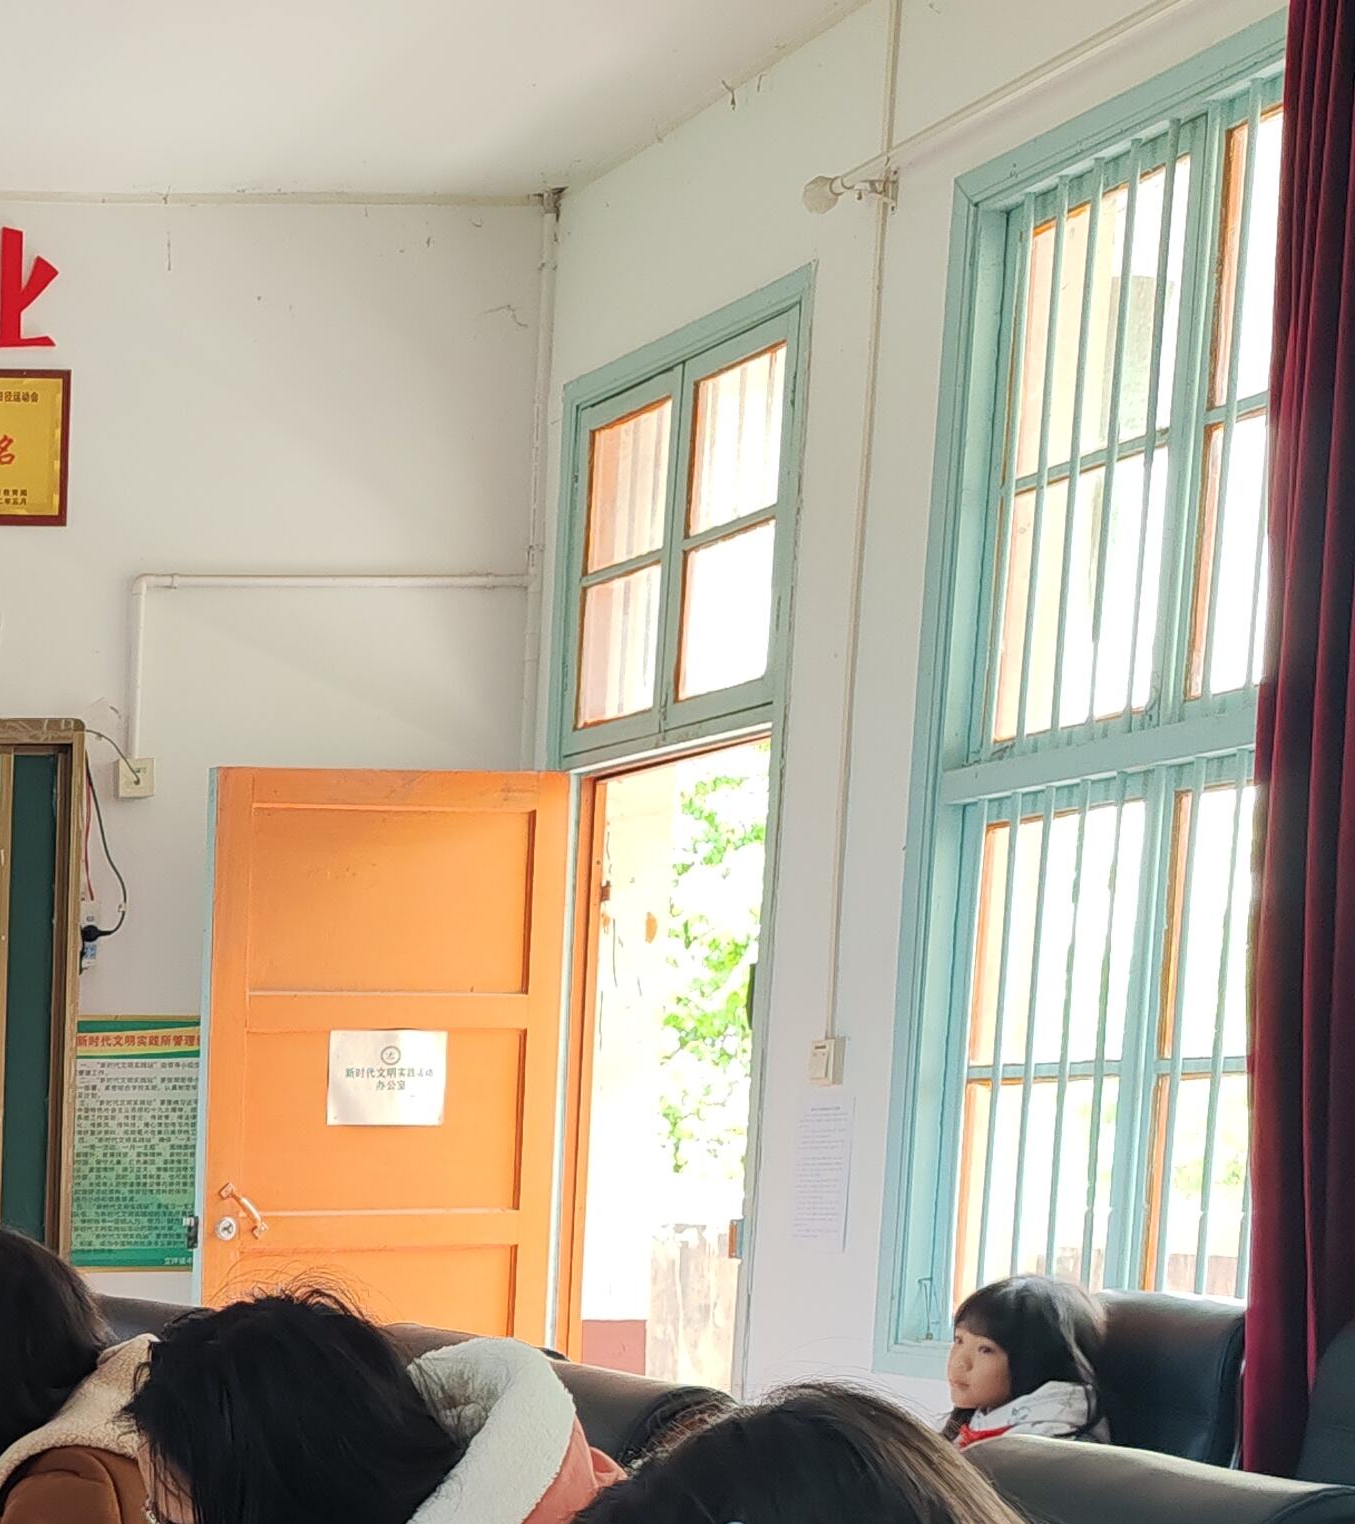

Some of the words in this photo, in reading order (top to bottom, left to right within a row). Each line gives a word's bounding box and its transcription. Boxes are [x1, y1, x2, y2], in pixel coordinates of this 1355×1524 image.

[76, 1035, 200, 1047] 新时代文明实践所管理
[376, 1080, 406, 1091] 办公室
